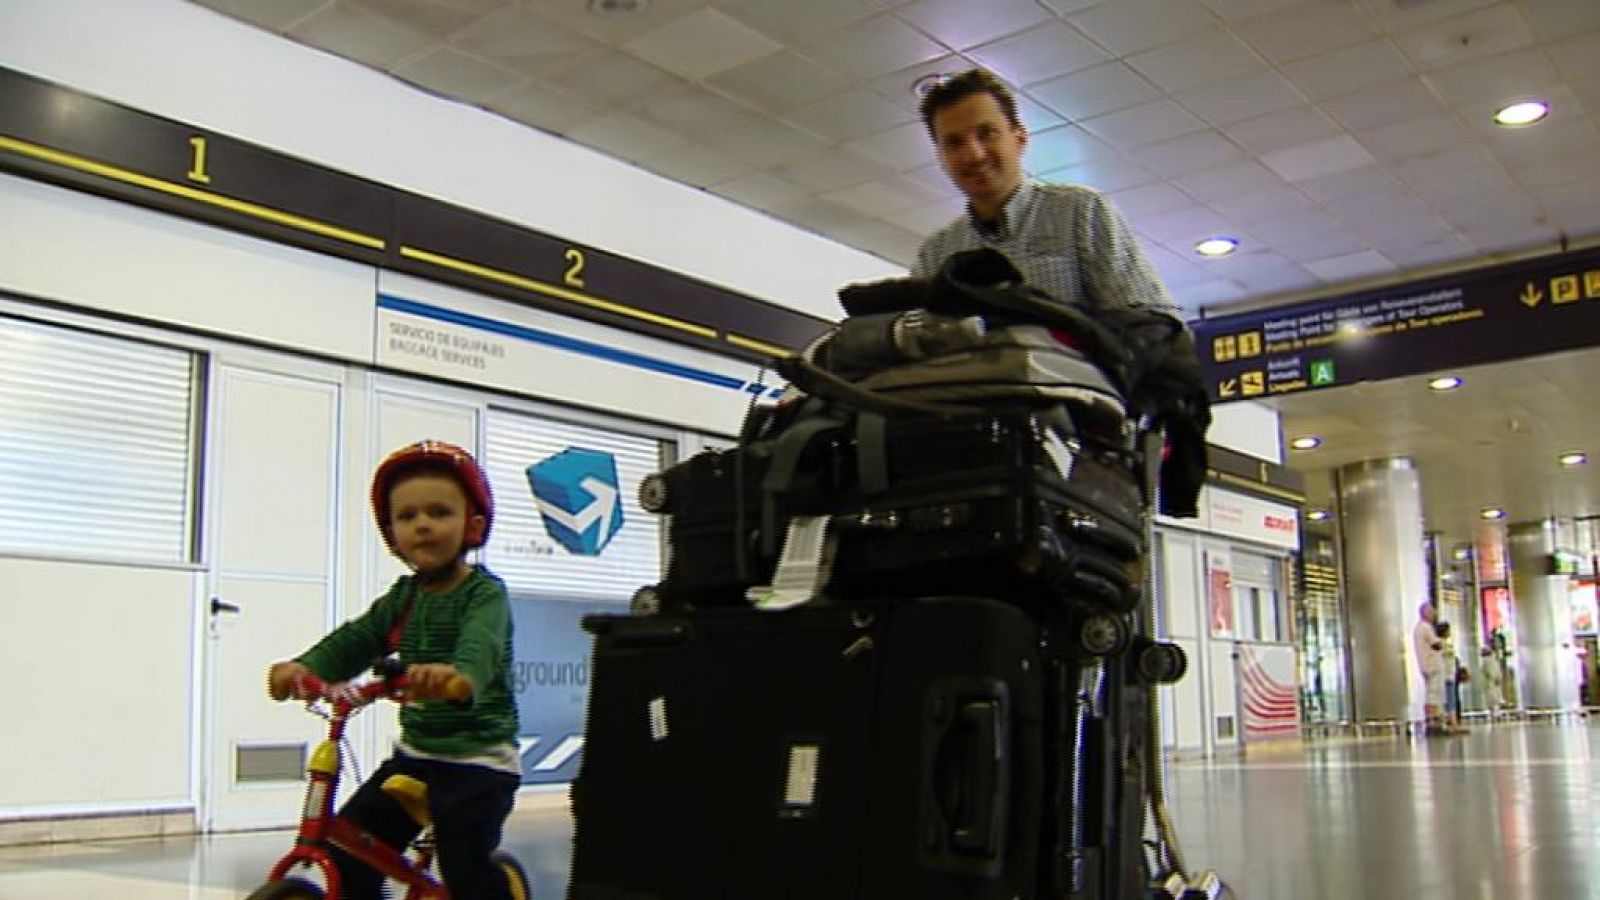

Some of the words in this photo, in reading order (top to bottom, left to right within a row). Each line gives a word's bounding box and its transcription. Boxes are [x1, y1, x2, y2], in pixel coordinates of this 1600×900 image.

[188, 137, 211, 183] 1
[565, 250, 586, 287] 2
[389, 322, 434, 342] SERVICIO
[437, 331, 451, 346] DE
[389, 337, 438, 361] BAGGAGE
[441, 349, 486, 370] SERVICES
